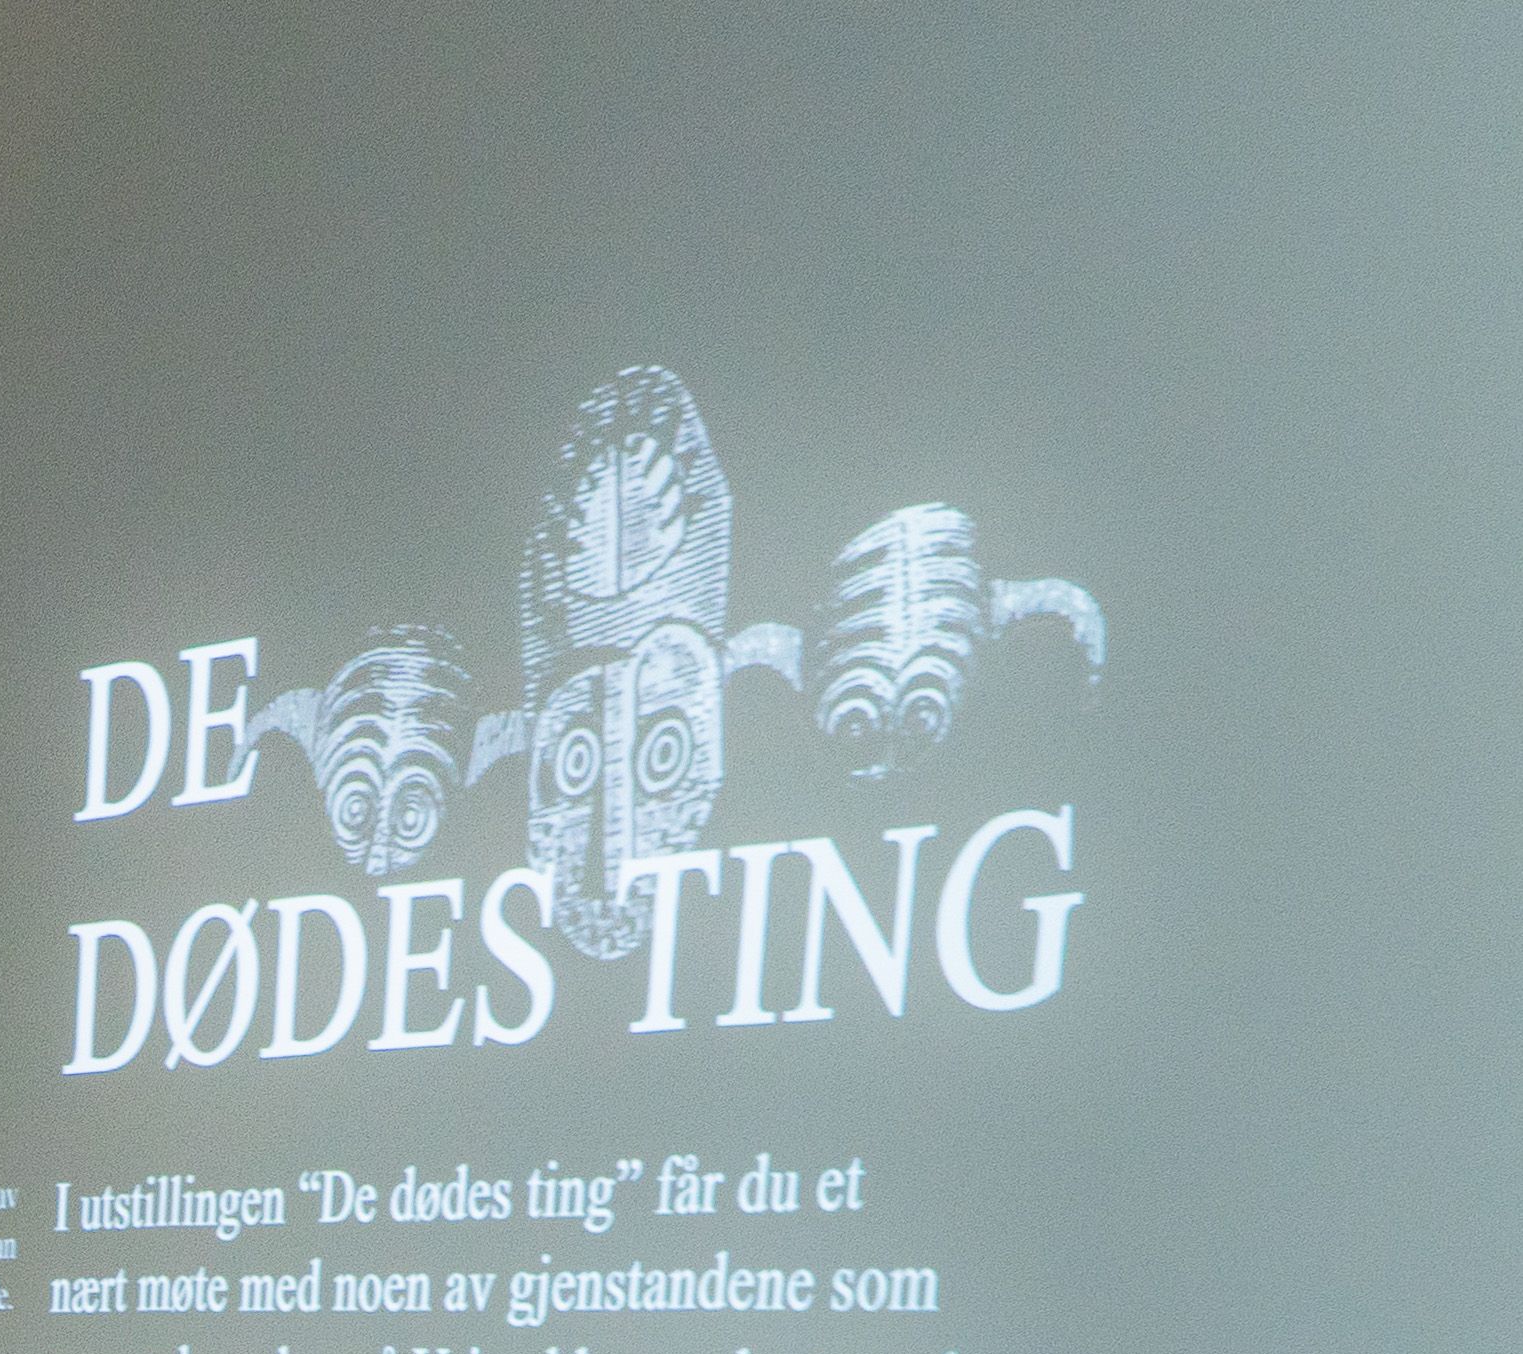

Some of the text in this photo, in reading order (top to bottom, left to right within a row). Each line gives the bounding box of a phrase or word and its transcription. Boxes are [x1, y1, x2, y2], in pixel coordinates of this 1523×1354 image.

[73, 637, 258, 821] DE
[63, 805, 1083, 1075] DØDES TING
[53, 1182, 72, 1232] I
[79, 1175, 286, 1241] utstillingen
[389, 1164, 512, 1223] dødes
[654, 1154, 725, 1215] får
[736, 1152, 800, 1213] du
[816, 1157, 866, 1212] et
[48, 1251, 939, 1327] nært møte med noen av gjenstandene som
